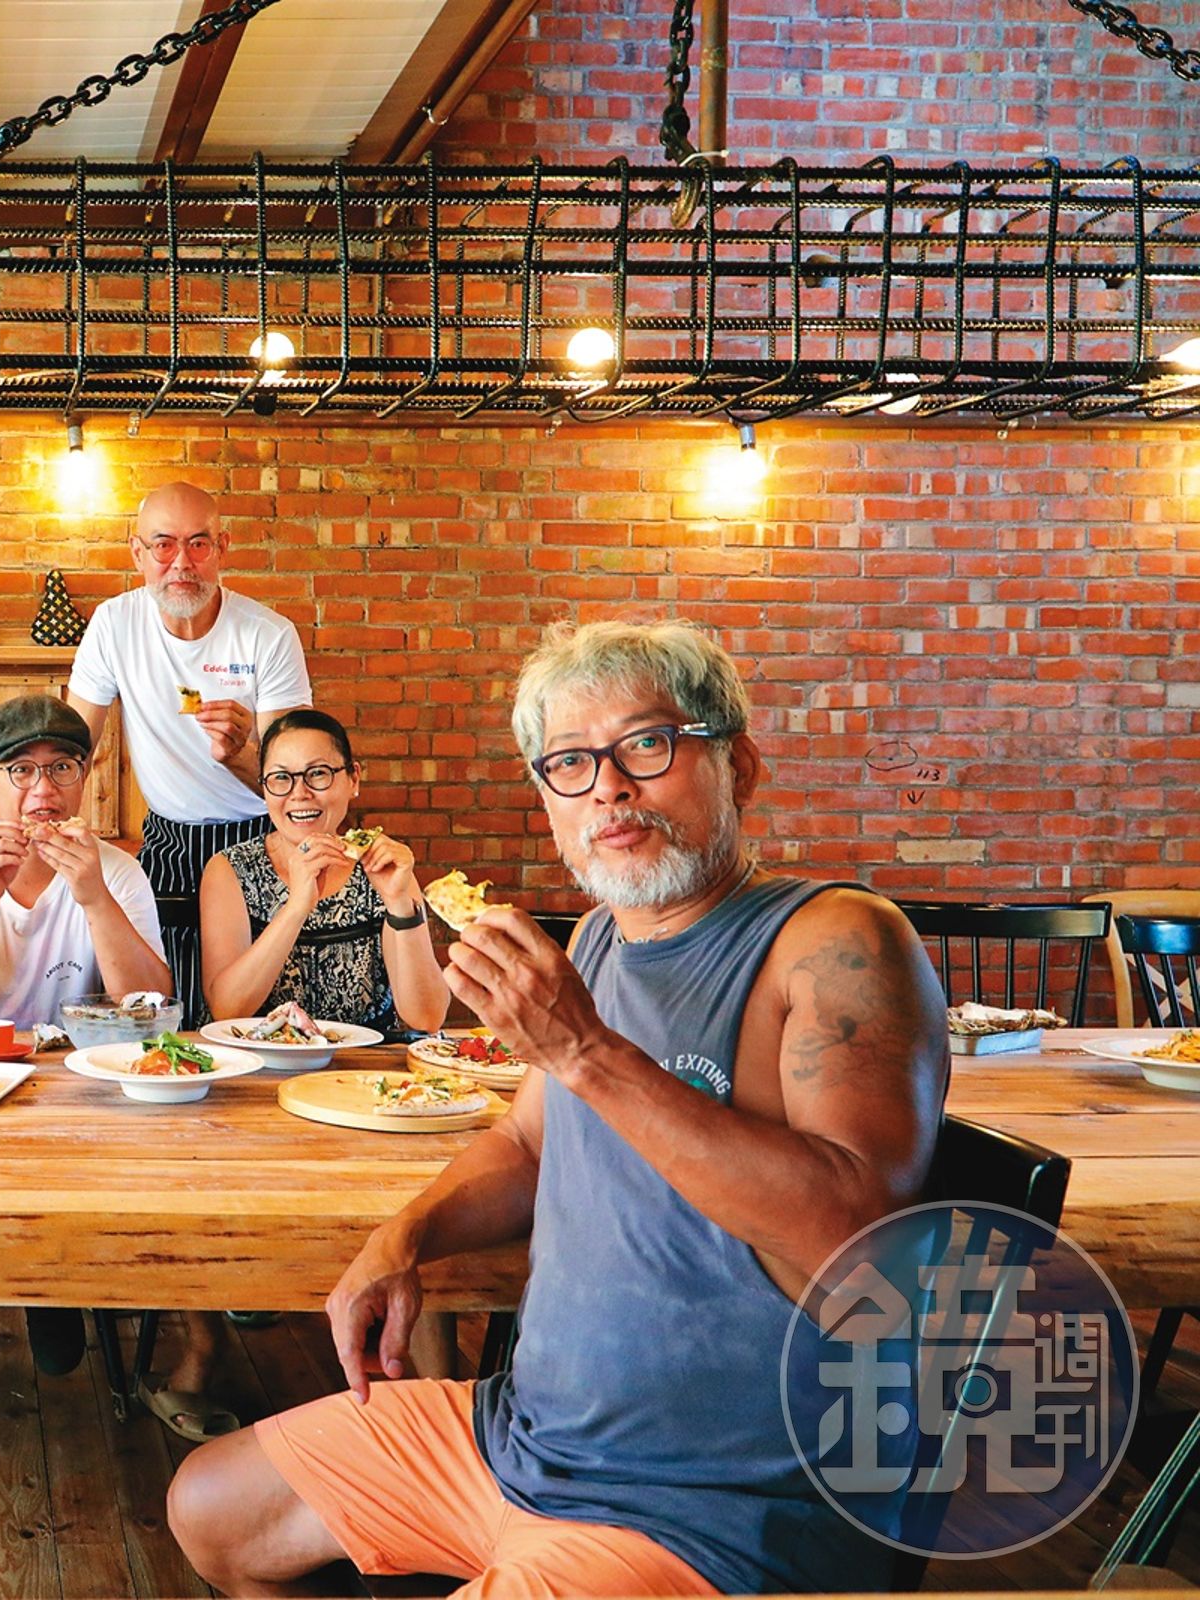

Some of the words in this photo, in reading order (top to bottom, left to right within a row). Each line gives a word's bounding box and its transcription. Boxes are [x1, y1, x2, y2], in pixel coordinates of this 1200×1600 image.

[219, 679, 246, 687] Taiwan
[916, 768, 941, 781] 113
[675, 1053, 732, 1096] EXITING
